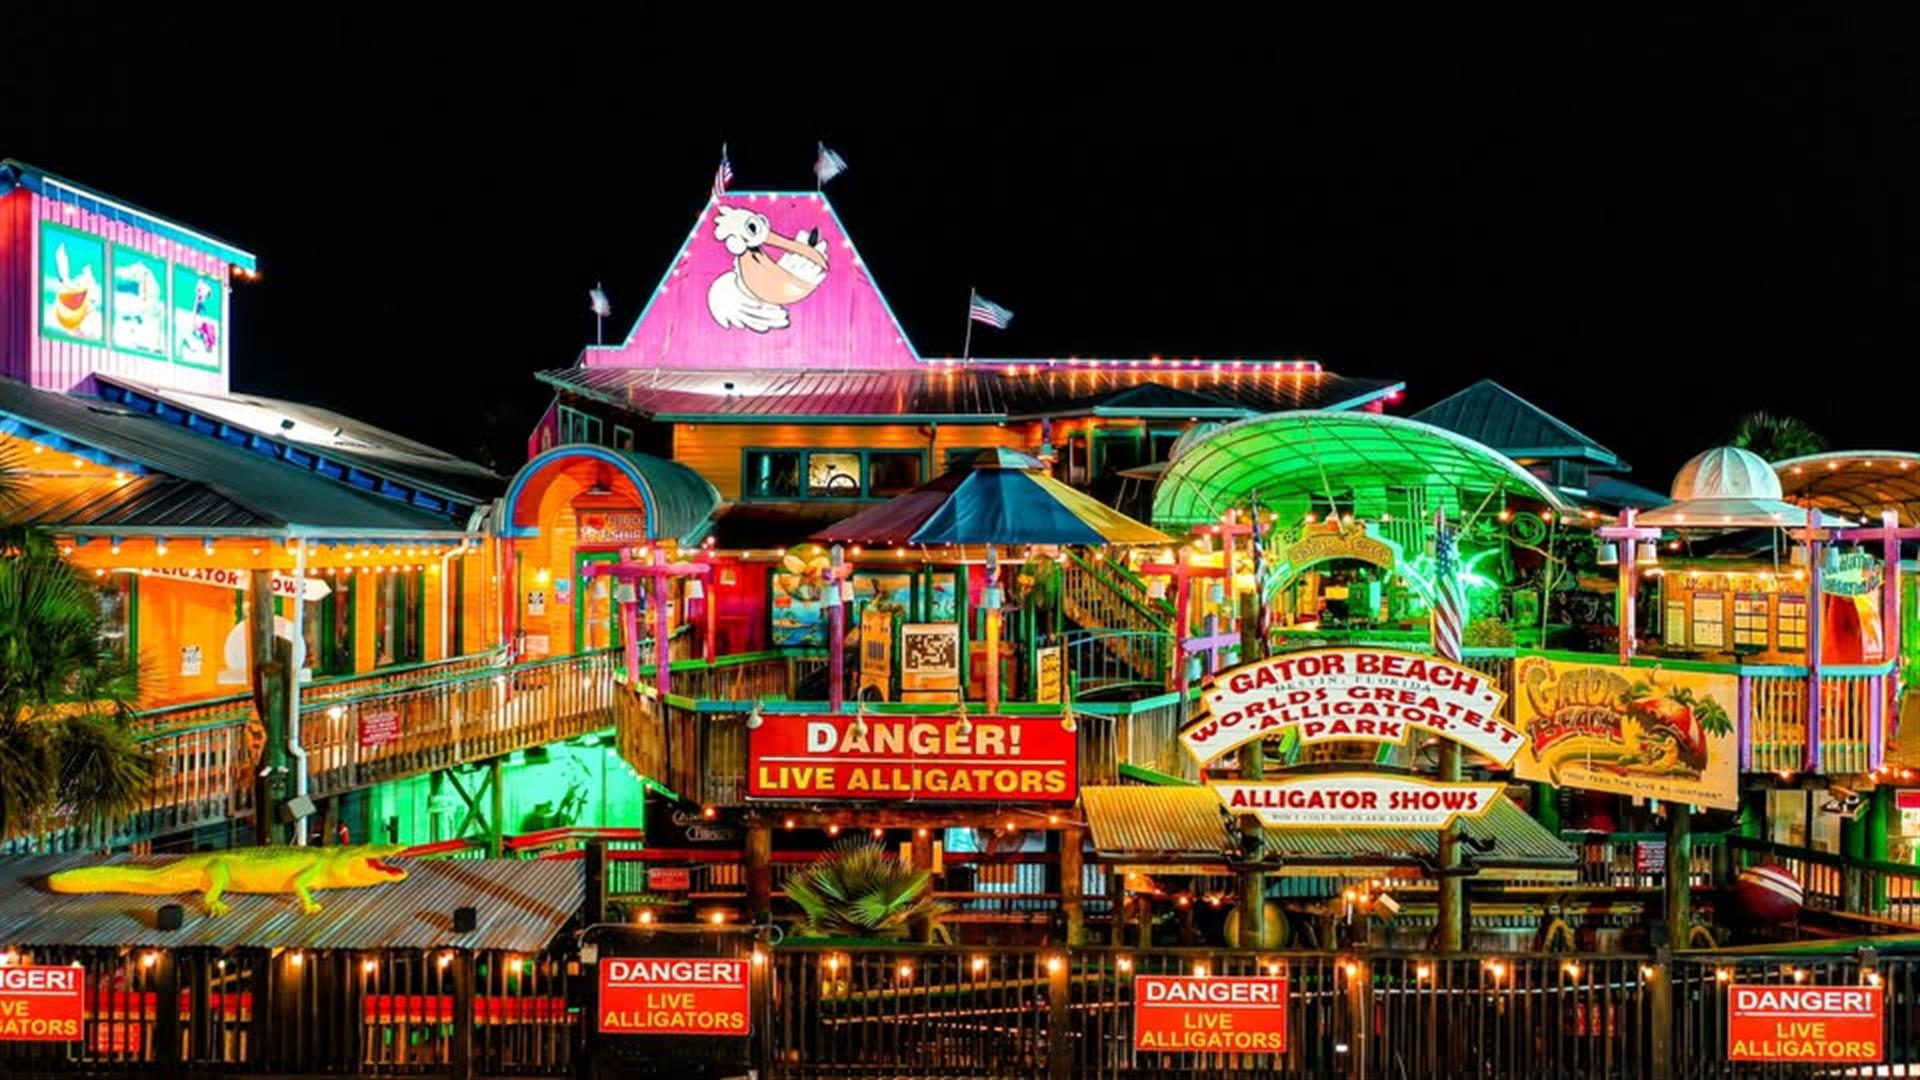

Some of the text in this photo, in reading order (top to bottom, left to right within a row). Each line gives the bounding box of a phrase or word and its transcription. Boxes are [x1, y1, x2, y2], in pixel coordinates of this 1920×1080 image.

[1229, 654, 1346, 694] GATOR
[1355, 653, 1480, 696] BEACH
[1355, 676, 1431, 692] FLORIDA
[1190, 685, 1519, 744] WORLDS GREATEST
[1260, 701, 1448, 731] ALLIGATOR
[806, 721, 1022, 755] DANGER!
[1303, 719, 1402, 738] PARK
[758, 767, 1067, 793] LIVE ALLIGATORS
[1231, 789, 1478, 810] ALLIGATOR SHOWS
[0, 969, 75, 990] GER!
[609, 961, 741, 983] DANGER!
[647, 993, 697, 1009] LIVE
[1146, 981, 1278, 1003] DANGER!
[1737, 990, 1872, 1012] DANGER!
[0, 1018, 78, 1036] ATORS
[604, 1011, 744, 1029] ALLIGATORS
[1184, 1013, 1233, 1030] LIVE
[1776, 1022, 1826, 1039] LIVE
[1140, 1031, 1281, 1049] ALLIGATORS
[1732, 1039, 1876, 1058] ALLIGATORS
